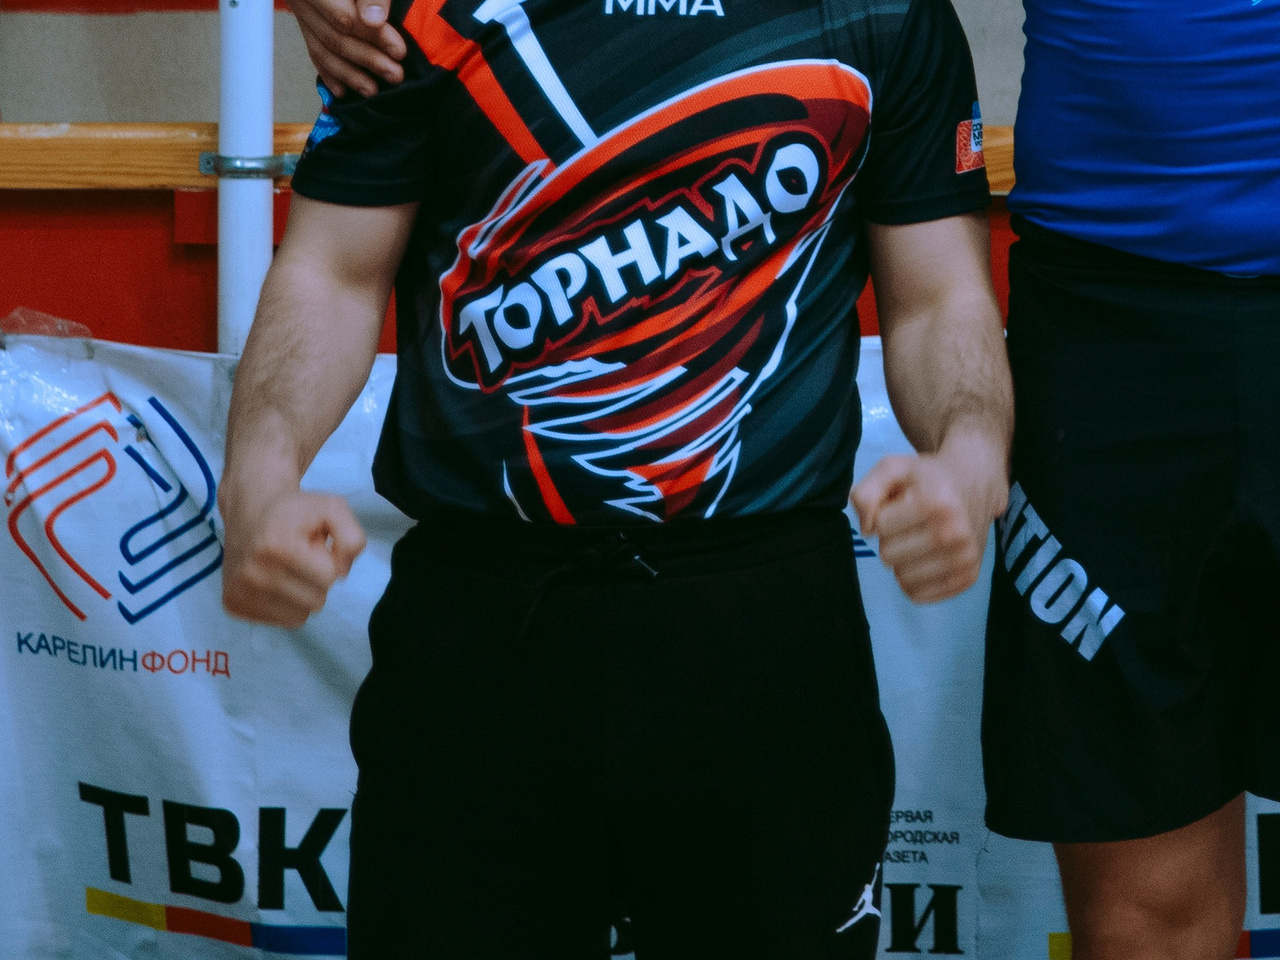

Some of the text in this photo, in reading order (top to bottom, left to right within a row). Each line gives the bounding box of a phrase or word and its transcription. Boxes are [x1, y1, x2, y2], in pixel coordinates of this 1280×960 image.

[459, 142, 820, 373] ТОРНАДО
[16, 631, 231, 678] КАРЕЛИНФОНД
[78, 781, 349, 912] ТВК
